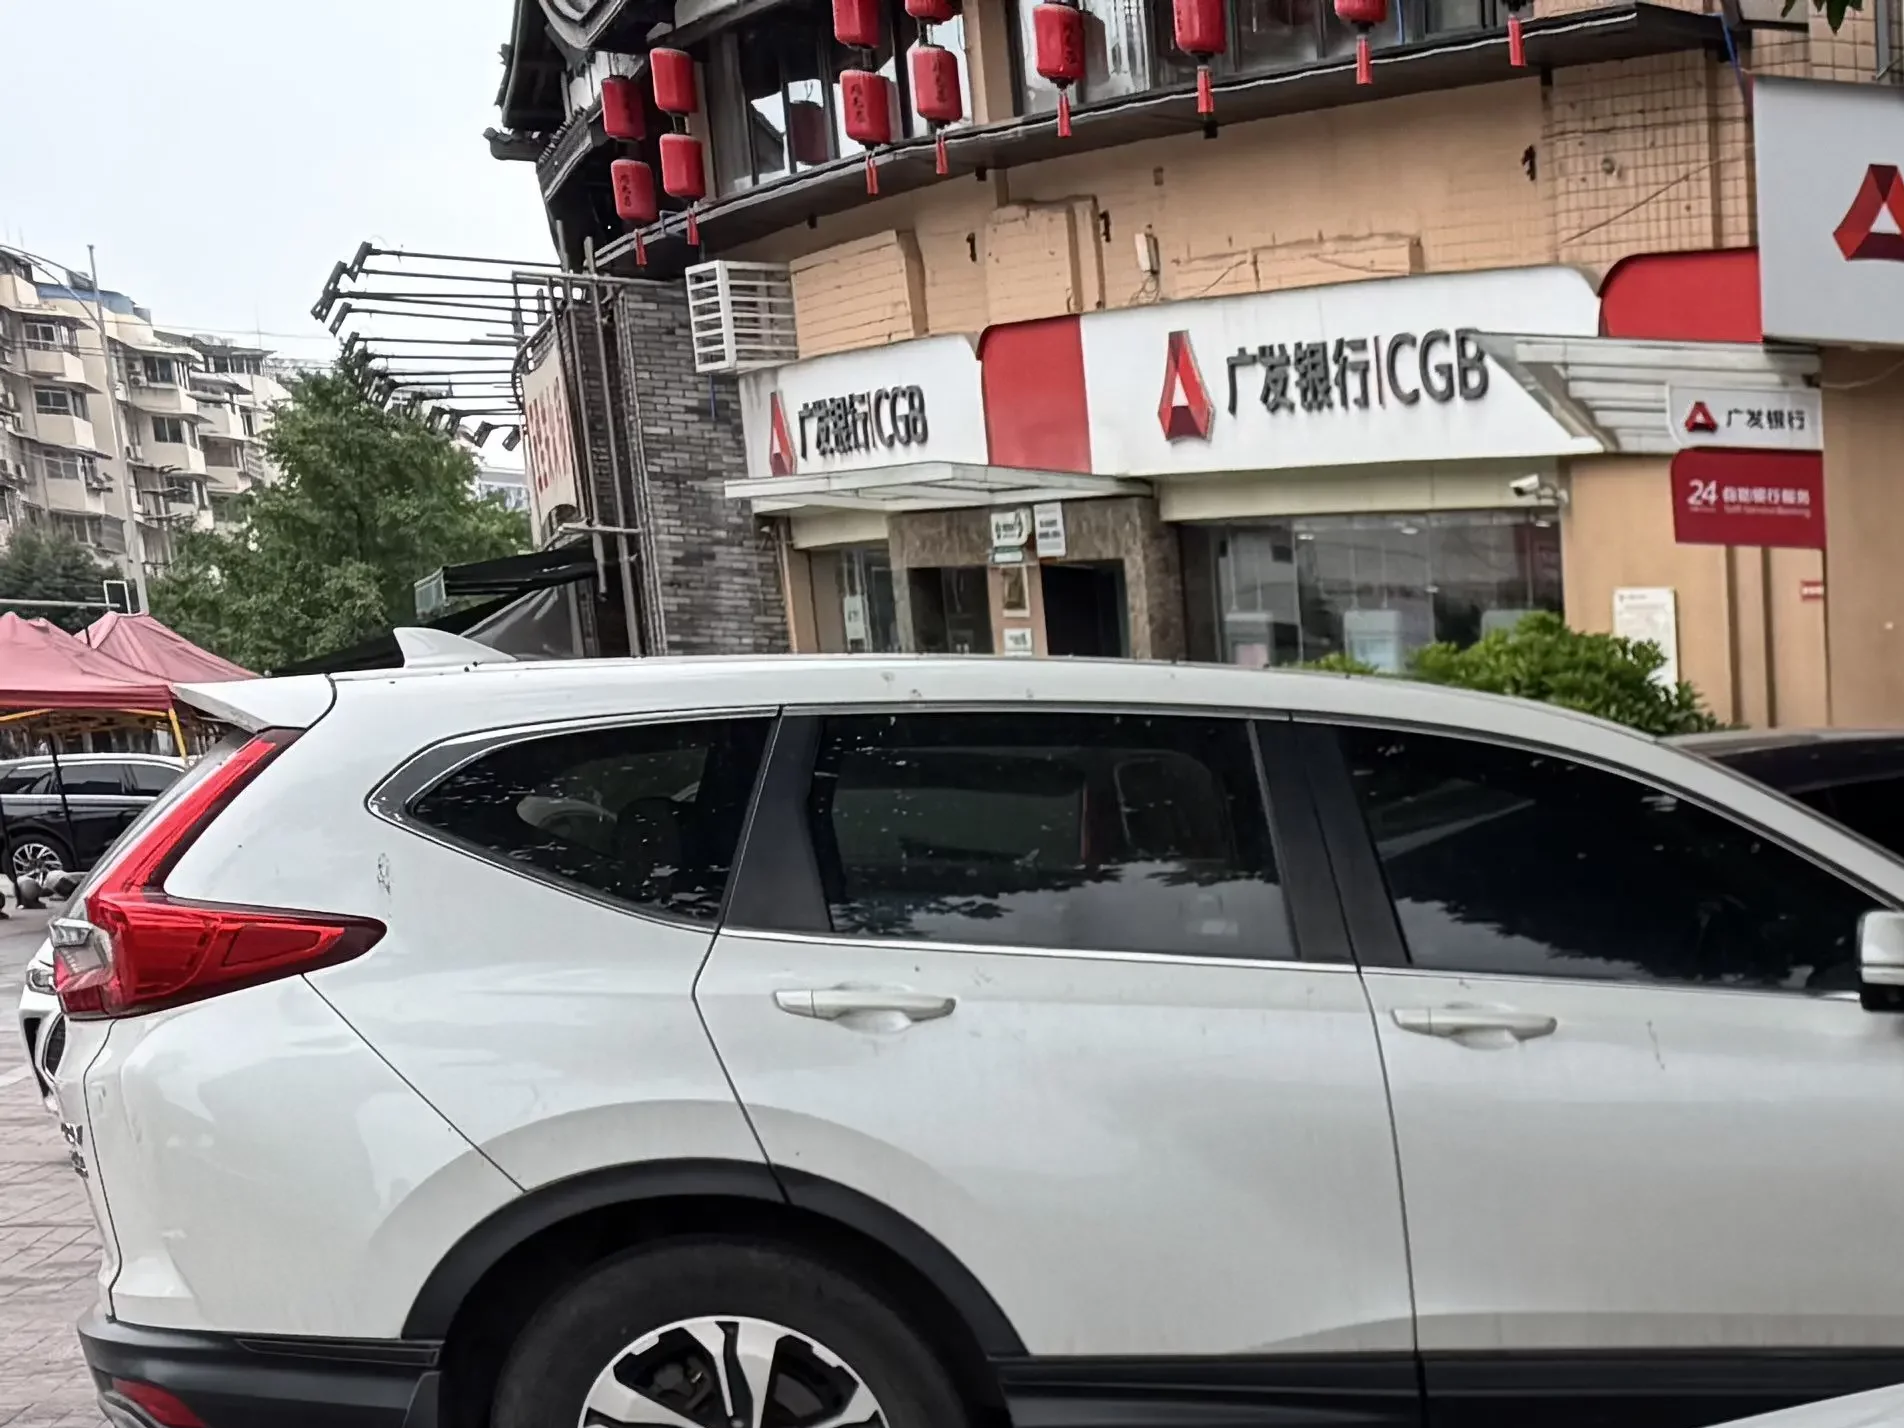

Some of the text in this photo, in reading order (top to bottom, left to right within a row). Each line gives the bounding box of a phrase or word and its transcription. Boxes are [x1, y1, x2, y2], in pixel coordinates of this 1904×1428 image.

[1225, 328, 1490, 418] 广发银行 CGB
[874, 384, 929, 448] CGB
[1725, 407, 1806, 431] 广发银行
[1686, 478, 1718, 506] 24
